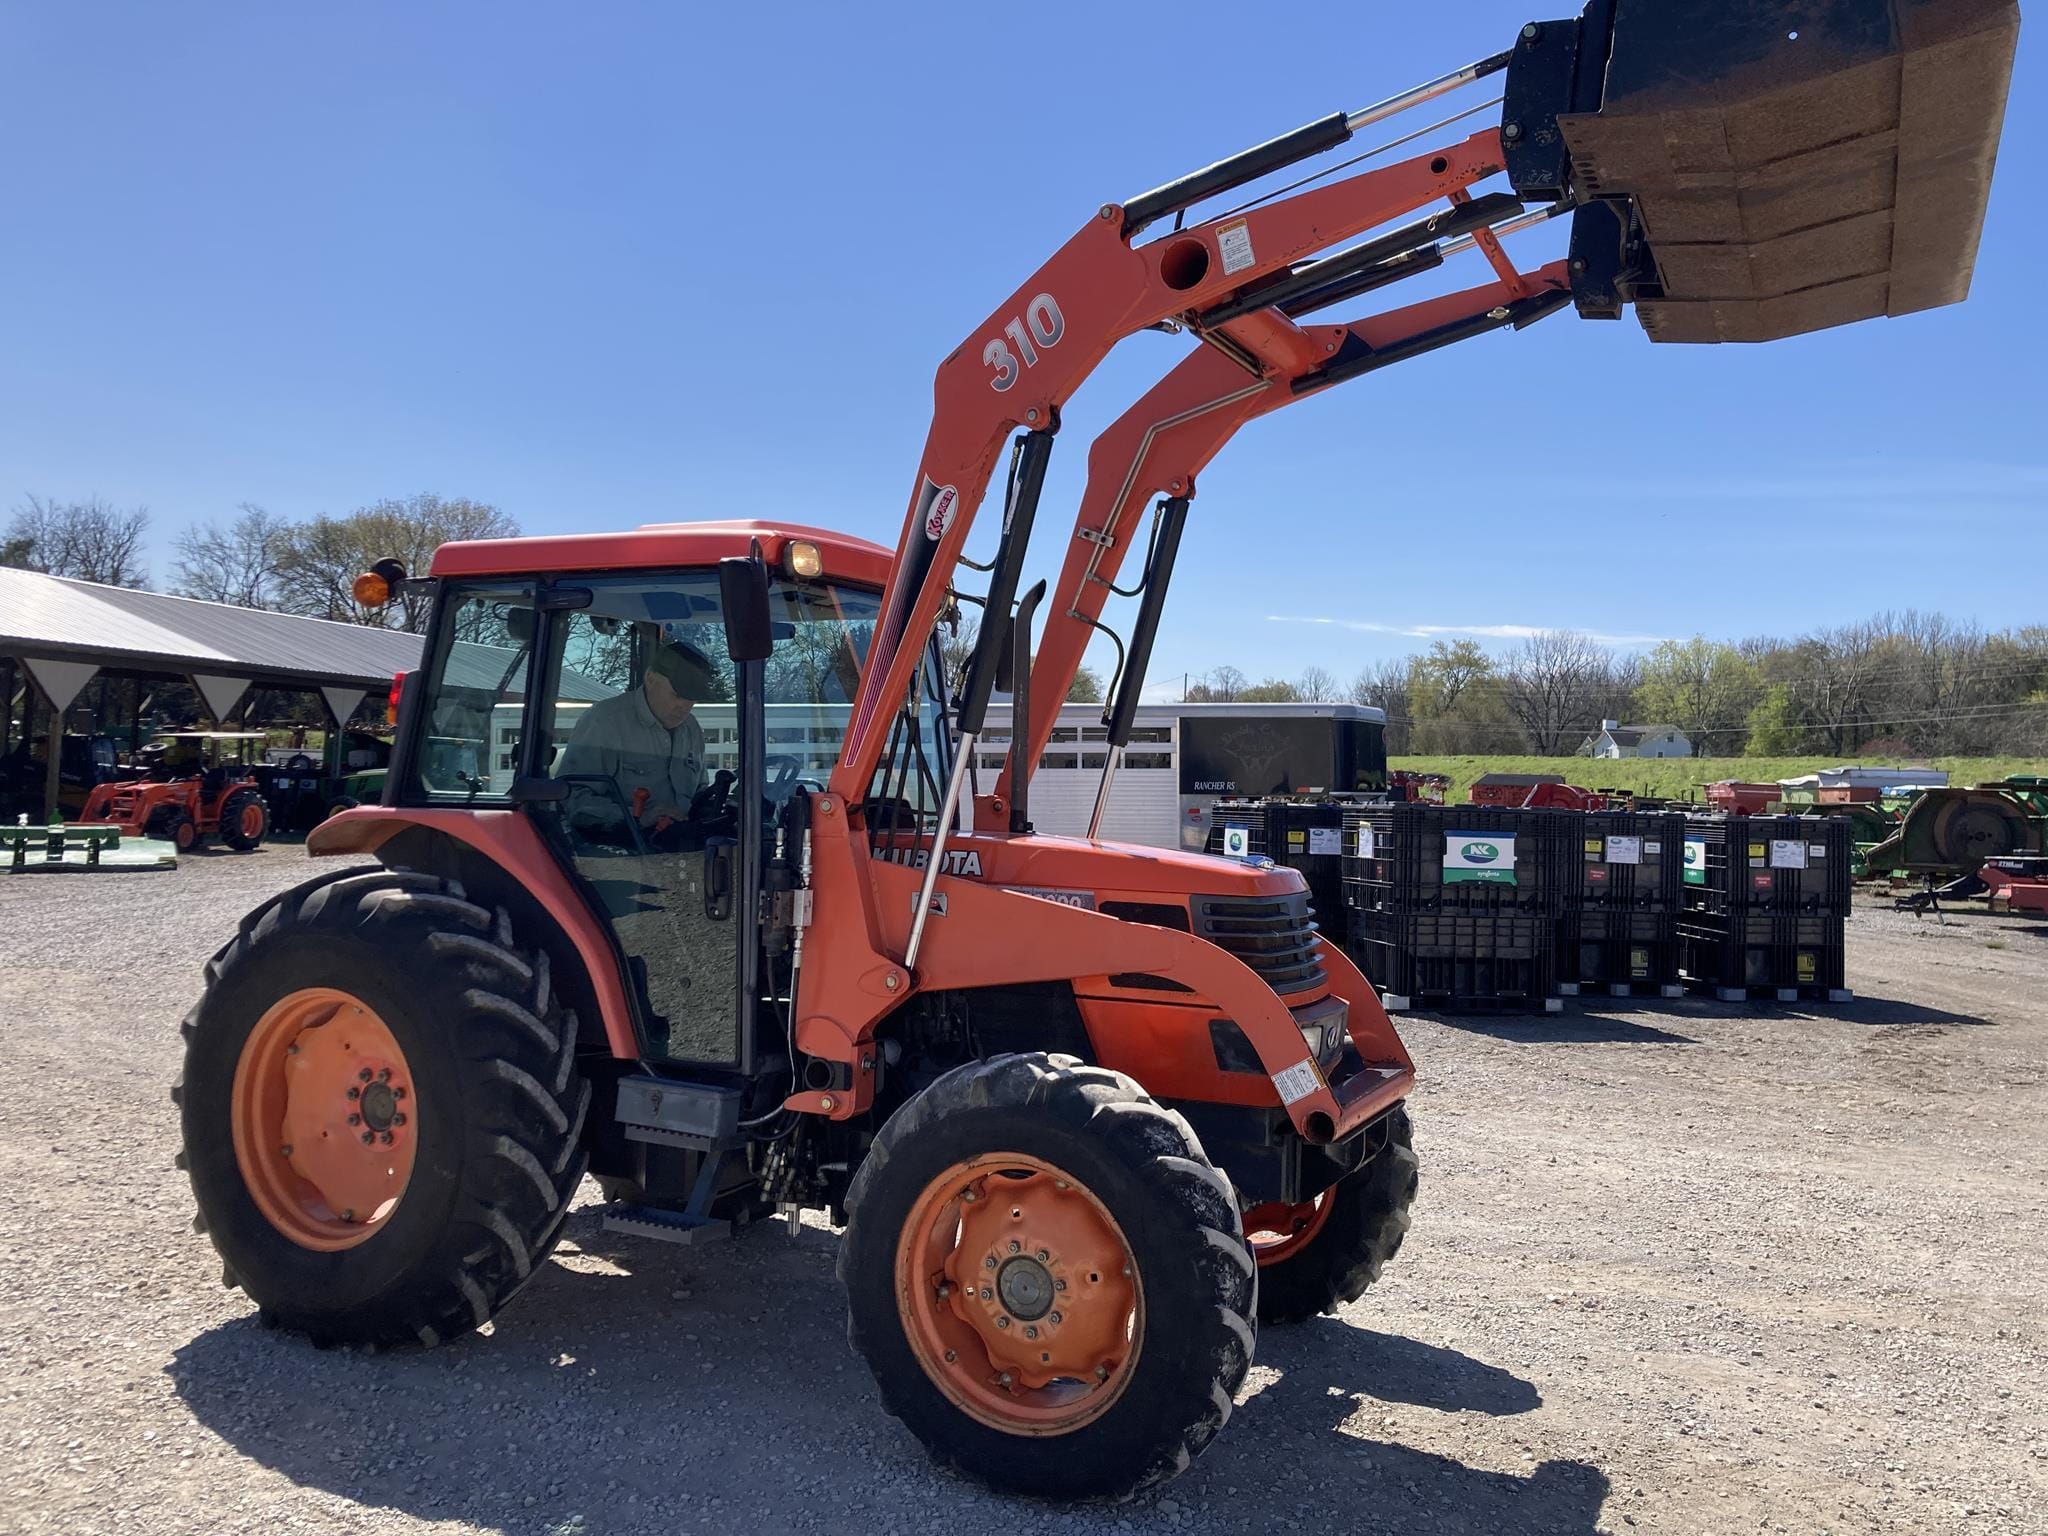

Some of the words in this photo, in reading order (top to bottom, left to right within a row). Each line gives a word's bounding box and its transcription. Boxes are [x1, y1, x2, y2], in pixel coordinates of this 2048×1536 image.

[983, 293, 1065, 392] 310
[927, 490, 956, 537] KOYKER
[1194, 781, 1225, 790] RANCHER
[1227, 781, 1235, 790] RS
[873, 847, 982, 876] KUBTA
[1470, 844, 1490, 855] NK
